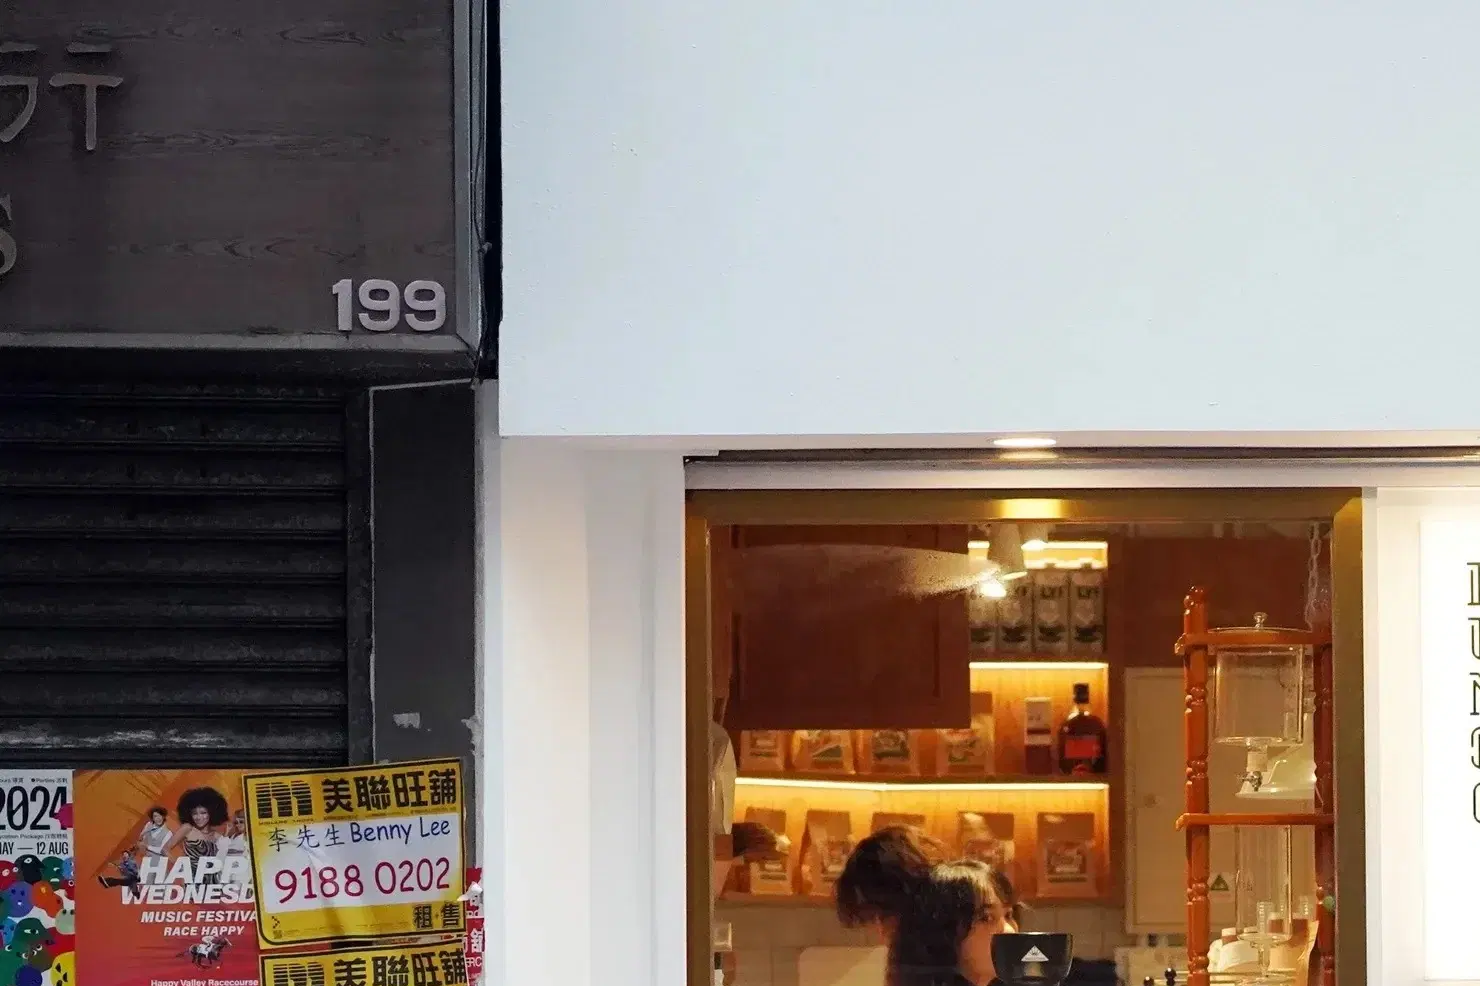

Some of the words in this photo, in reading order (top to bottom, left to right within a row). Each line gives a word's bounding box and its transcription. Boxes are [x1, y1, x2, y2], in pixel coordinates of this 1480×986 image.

[332, 278, 446, 332] 199
[321, 769, 457, 814] 美聯旺舖
[268, 825, 345, 852] 李先生
[350, 822, 412, 844] Benny
[419, 817, 450, 837] Lee
[36, 842, 46, 855] 12
[48, 842, 68, 855] AUG
[139, 856, 252, 884] HAPP
[274, 864, 364, 903] 9188
[374, 857, 450, 894] 0202
[121, 884, 255, 905] WEDNESD
[140, 911, 193, 923] MUSIC
[196, 910, 257, 922] FESTIVA
[163, 926, 198, 937] RACE
[201, 925, 245, 936] HAPPY
[208, 979, 259, 986] Racecourse
